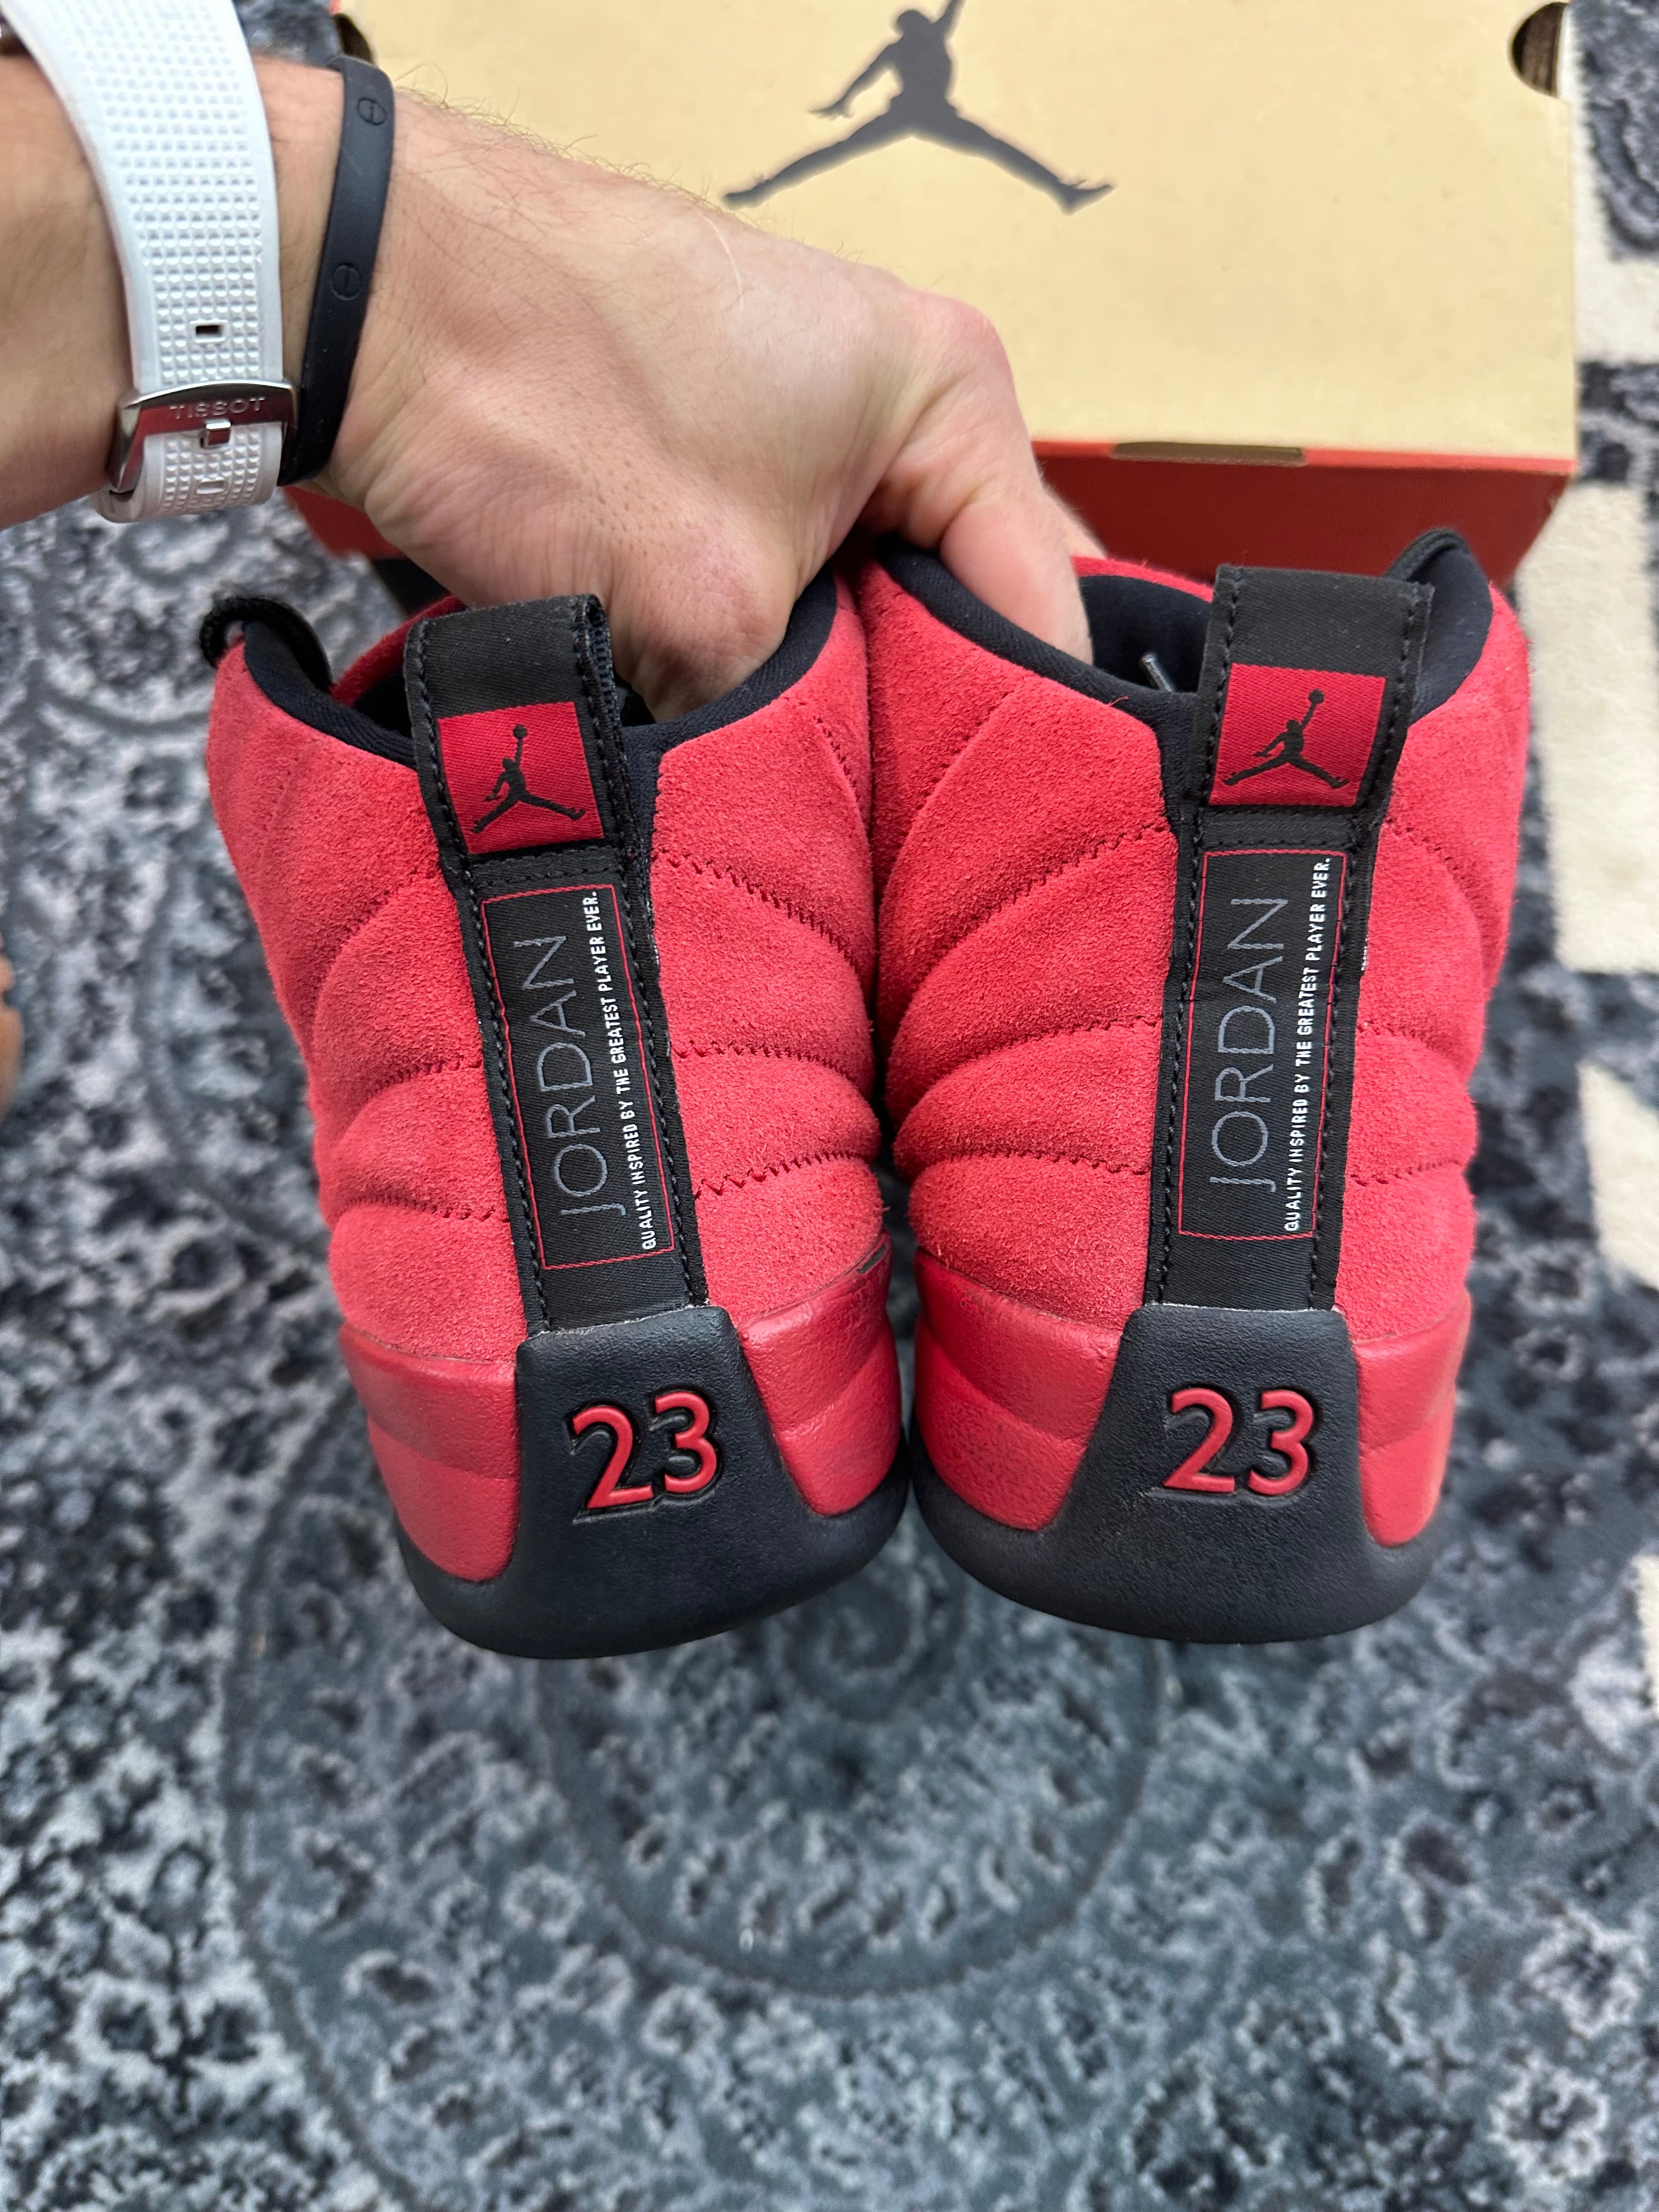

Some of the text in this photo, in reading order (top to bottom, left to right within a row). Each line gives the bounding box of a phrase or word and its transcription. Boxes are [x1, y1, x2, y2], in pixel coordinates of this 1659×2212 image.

[170, 396, 267, 420] TISSOT
[514, 936, 626, 1216] JORDAN
[582, 891, 657, 1250] QUALITY INSPIRED BY THE GREATEST PLAYER EVER.
[1210, 899, 1288, 1193] JORDAN
[1284, 857, 1333, 1232] QUALITY INSPIRED BY THE GREATEST PLAYER EVER.
[572, 1390, 717, 1509] 23
[1162, 1387, 1314, 1496] 23
